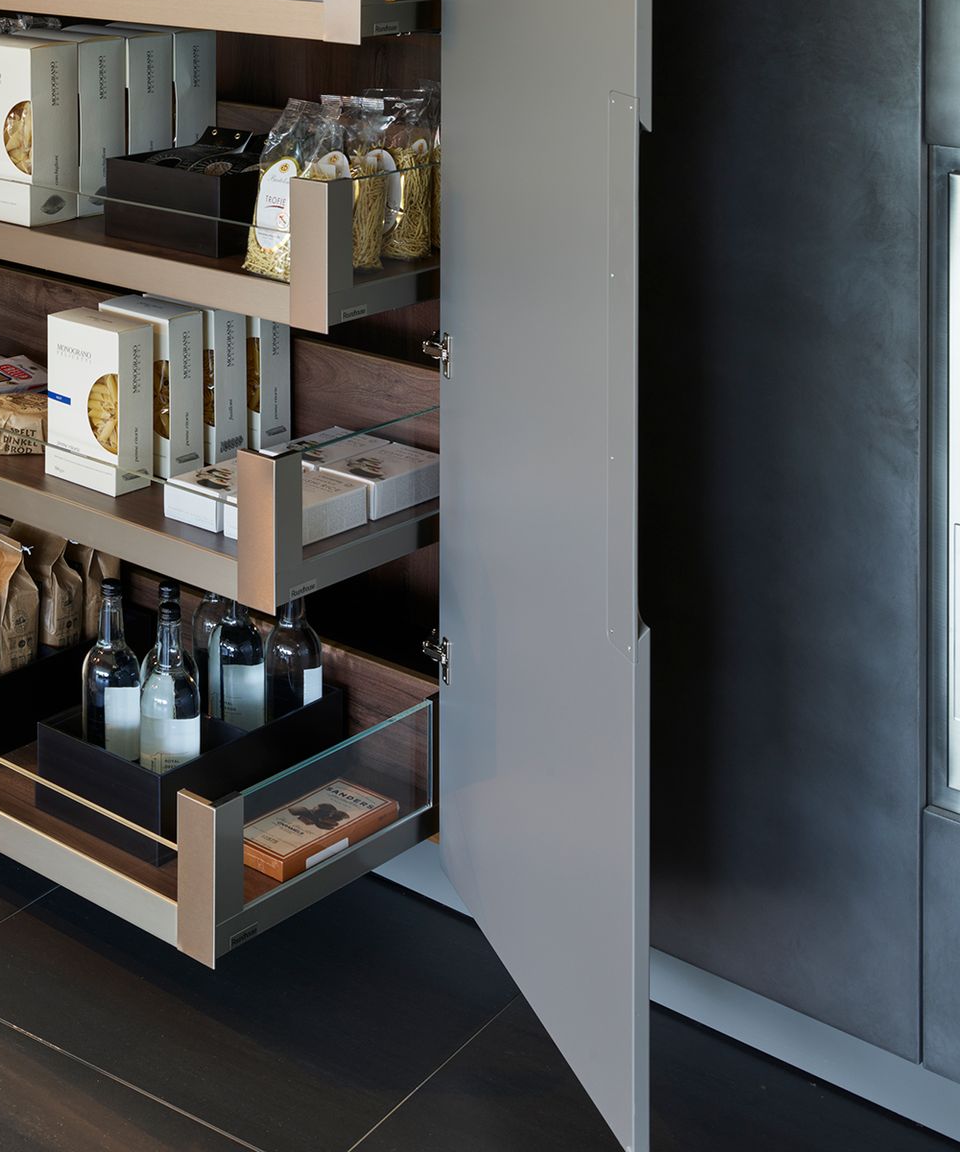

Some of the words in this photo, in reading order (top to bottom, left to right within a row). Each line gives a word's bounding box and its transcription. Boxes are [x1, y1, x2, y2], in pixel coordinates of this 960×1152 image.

[266, 194, 287, 206] TROFIE
[57, 344, 92, 359] MONOGRANO
[3, 435, 39, 448] DINKEL
[325, 786, 376, 810] SANDERS
